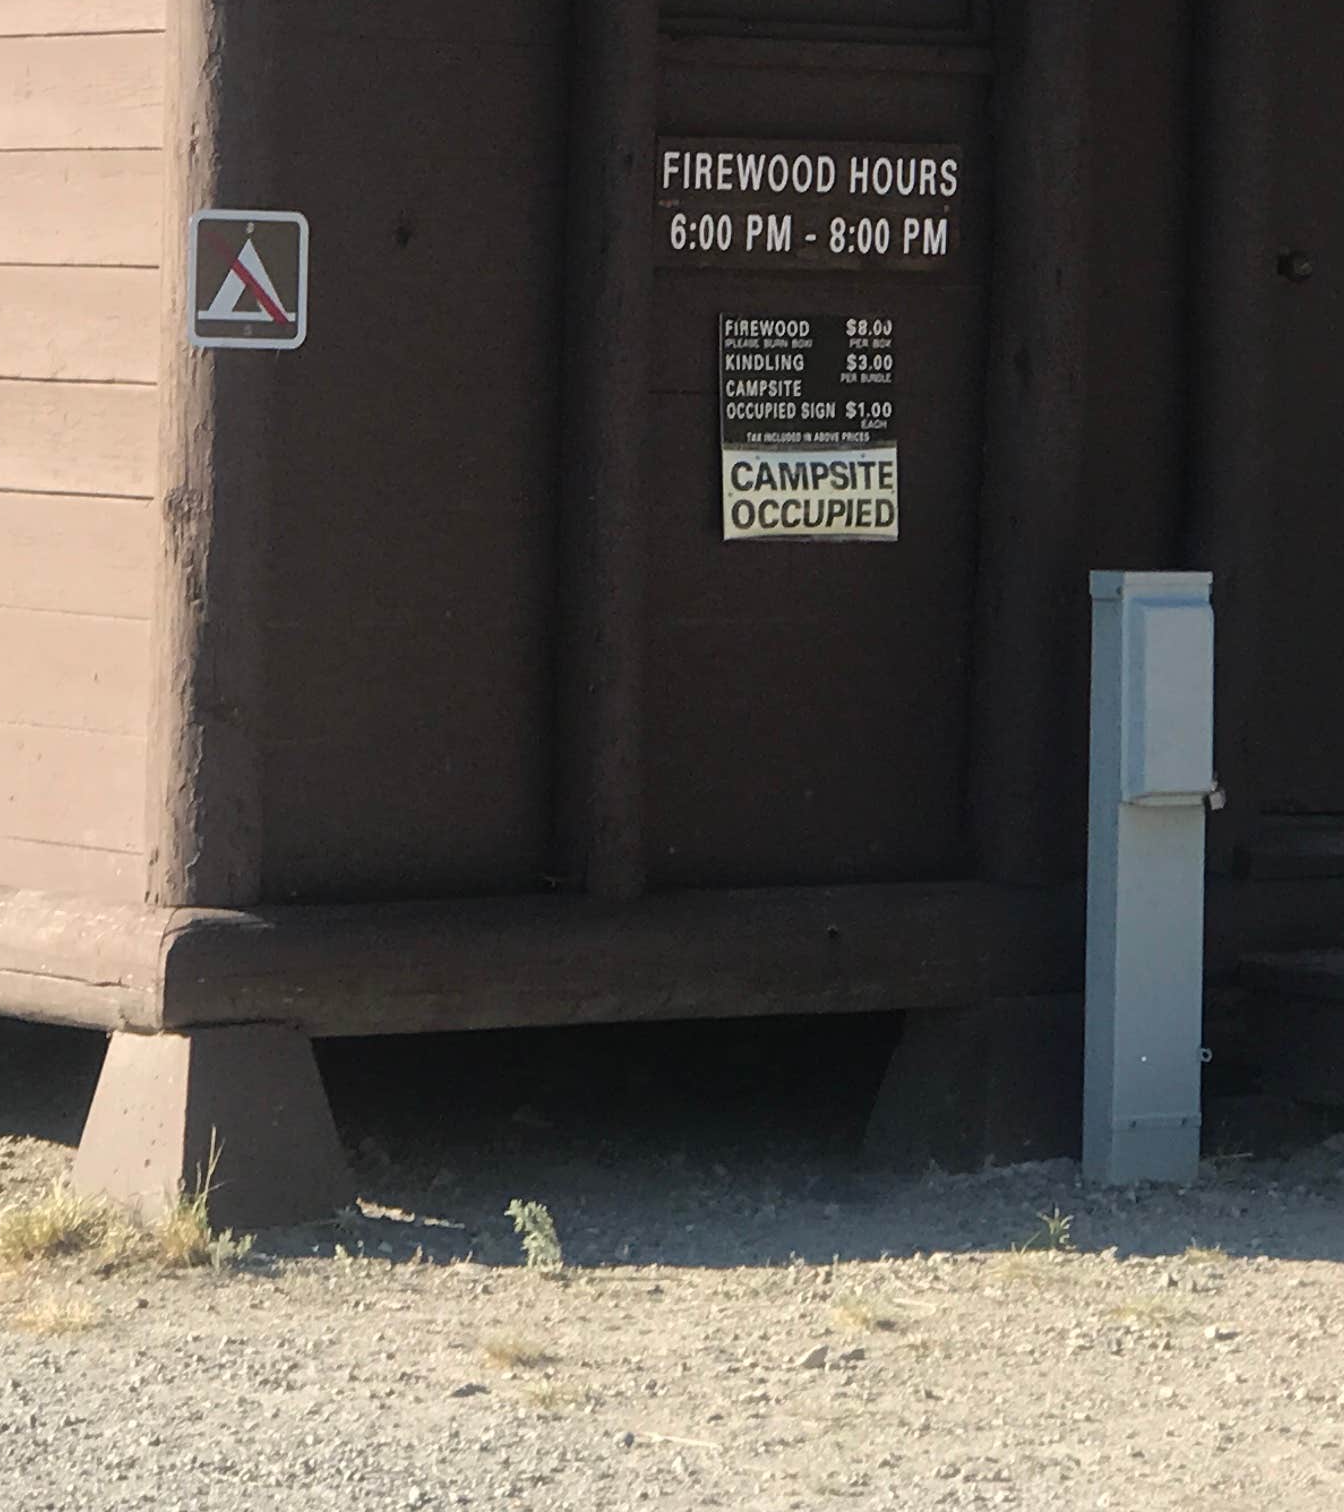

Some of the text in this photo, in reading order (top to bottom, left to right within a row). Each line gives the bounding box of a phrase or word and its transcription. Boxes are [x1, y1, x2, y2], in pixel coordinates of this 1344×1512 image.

[663, 152, 958, 196] FIREWOOD HOURS
[670, 213, 732, 251] 6:00
[746, 214, 792, 252] PM
[829, 217, 889, 254] 8:00
[903, 217, 948, 255] PM
[725, 319, 893, 337] FIREWOOD $8.00
[849, 339, 892, 348] PER BOX
[725, 354, 893, 372] KINDLING $3.00
[840, 373, 892, 383] PER BUNDLE
[726, 380, 802, 397] CAMPSITE
[726, 402, 892, 419] OCCUPIED SIGN $1.00
[861, 420, 887, 429] EACH
[747, 432, 761, 442] TAX
[764, 432, 801, 442] INCLUDED
[814, 432, 839, 441] ABOVE
[842, 432, 870, 441] PRICES
[731, 461, 893, 491] CAMPSITE
[731, 499, 895, 530] OCCUPIED
